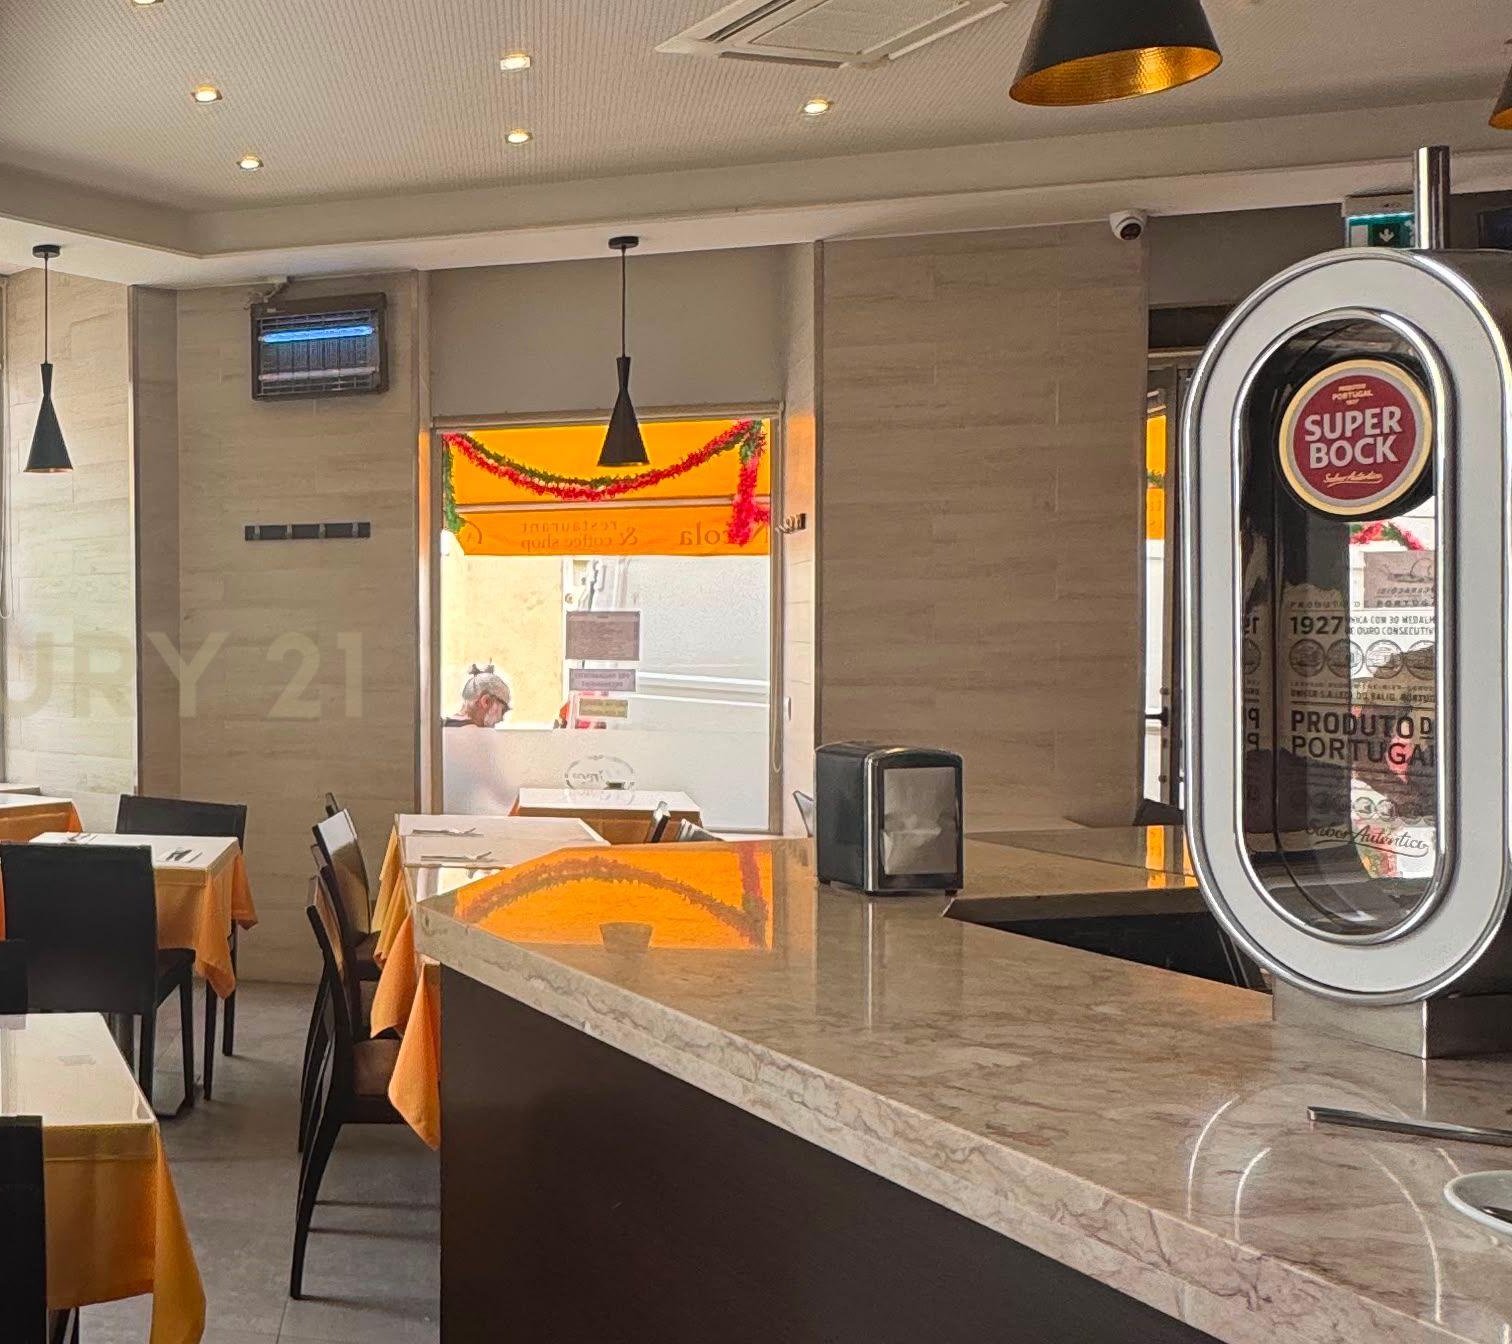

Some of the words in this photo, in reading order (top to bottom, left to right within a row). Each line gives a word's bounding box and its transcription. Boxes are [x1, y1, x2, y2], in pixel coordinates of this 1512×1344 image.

[1304, 405, 1402, 442] SUPER
[1309, 434, 1399, 469] BOCK
[1290, 615, 1344, 635] 1927
[1290, 709, 1415, 739] PRODUTO
[1420, 716, 1434, 735] D
